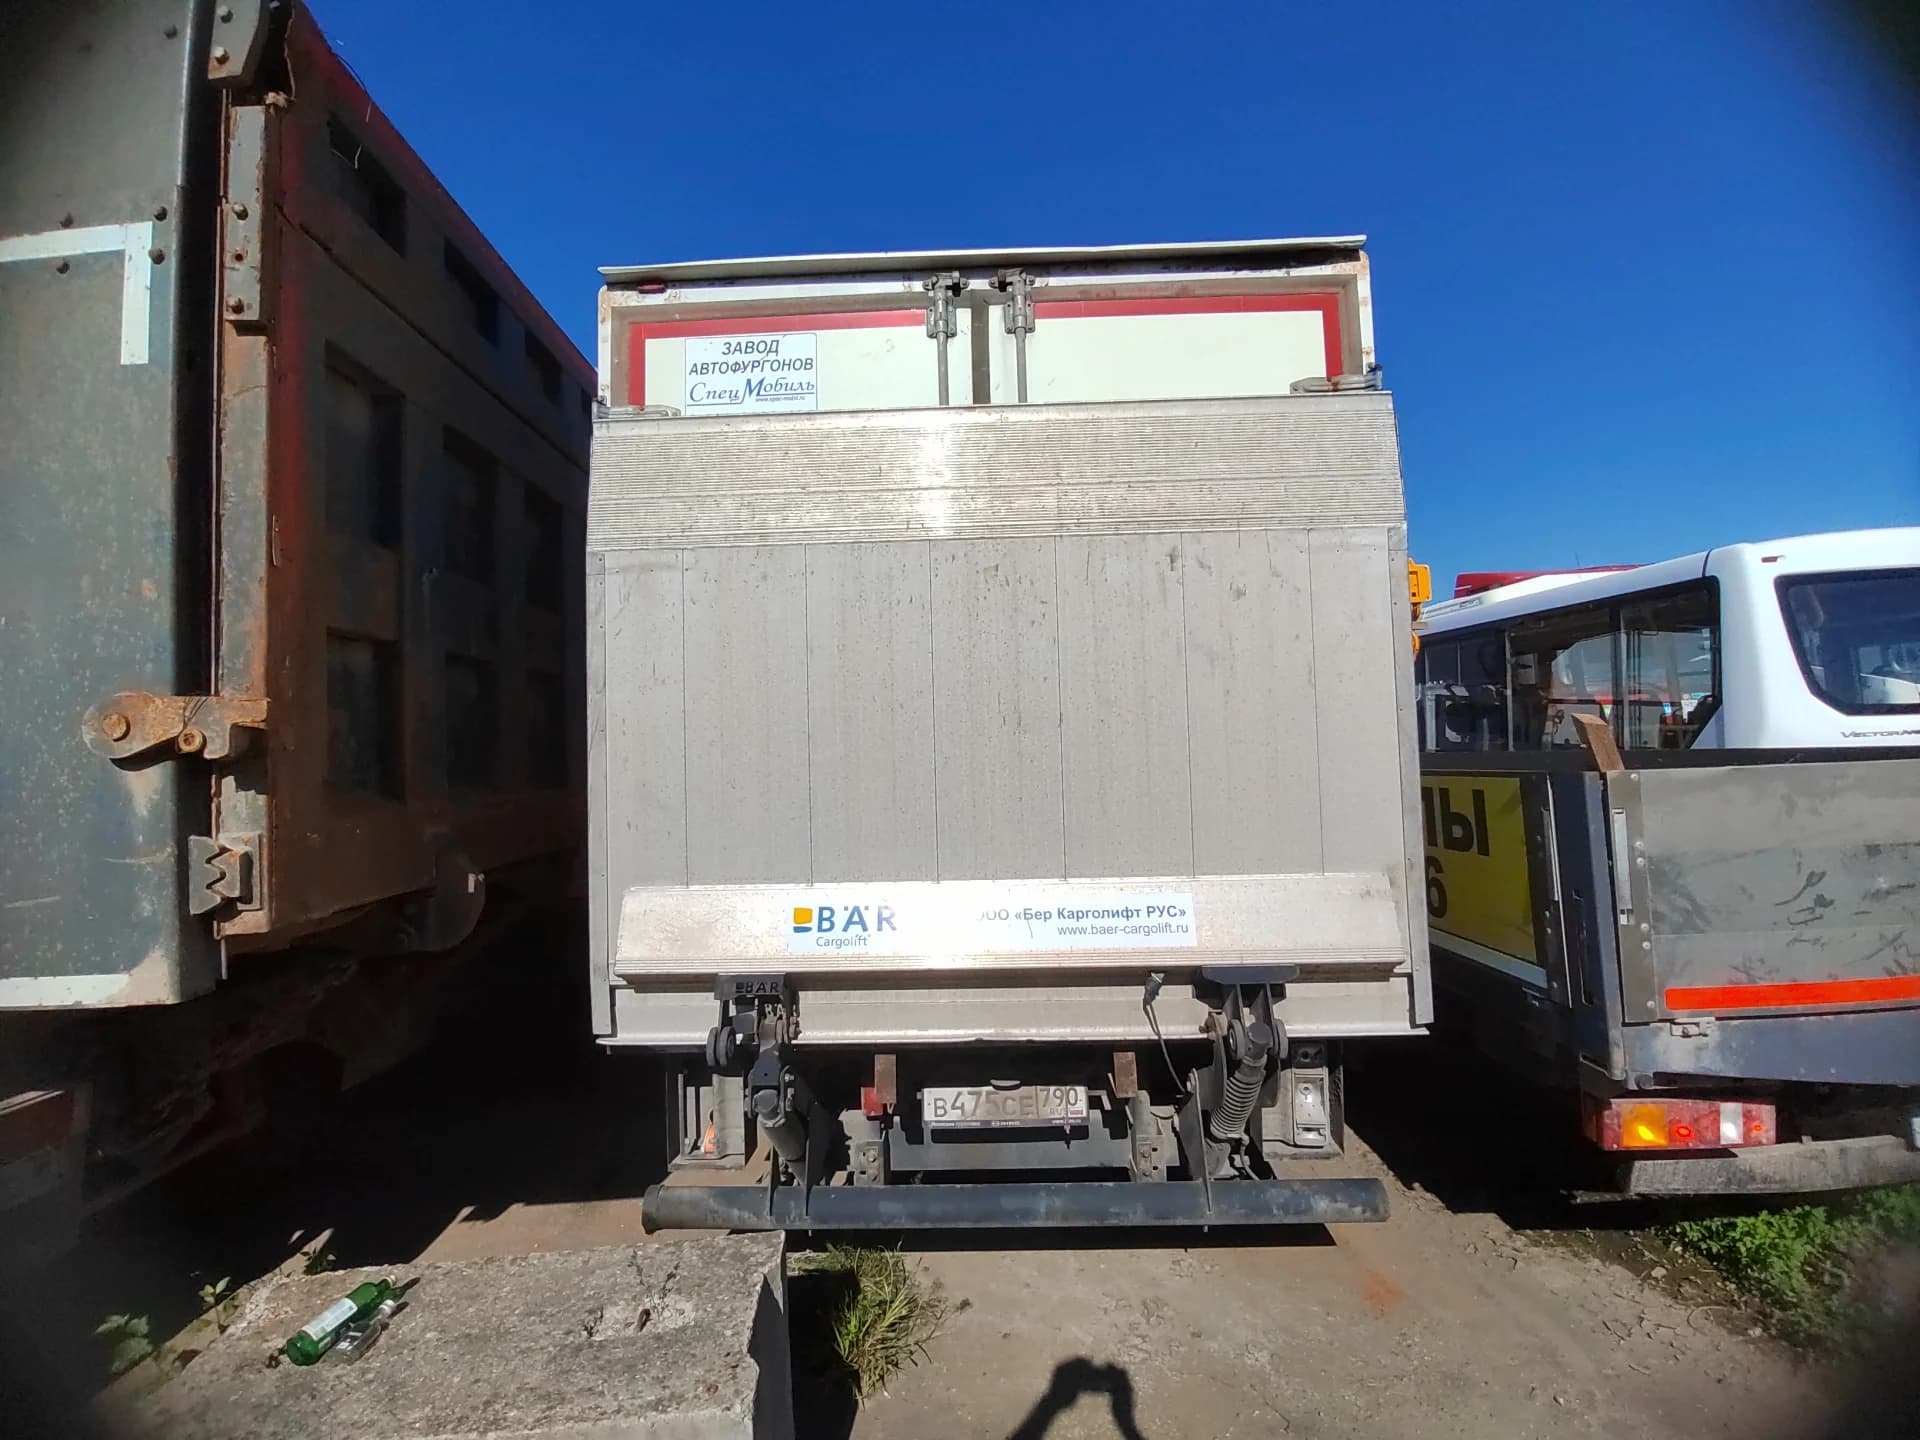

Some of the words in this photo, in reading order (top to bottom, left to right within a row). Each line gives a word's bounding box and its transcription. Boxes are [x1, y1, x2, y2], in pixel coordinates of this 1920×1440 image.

[721, 339, 780, 356] ЗАВОД
[688, 358, 814, 375] АВТОФУРГОНОВ
[816, 905, 897, 933] BÄR
[1057, 905, 1142, 922] Карголифт
[1146, 905, 1187, 918] РУС»
[1057, 921, 1189, 937] www.baer-cargolift.ru
[816, 935, 868, 949] Cargolift
[1039, 1087, 1078, 1108] 790
